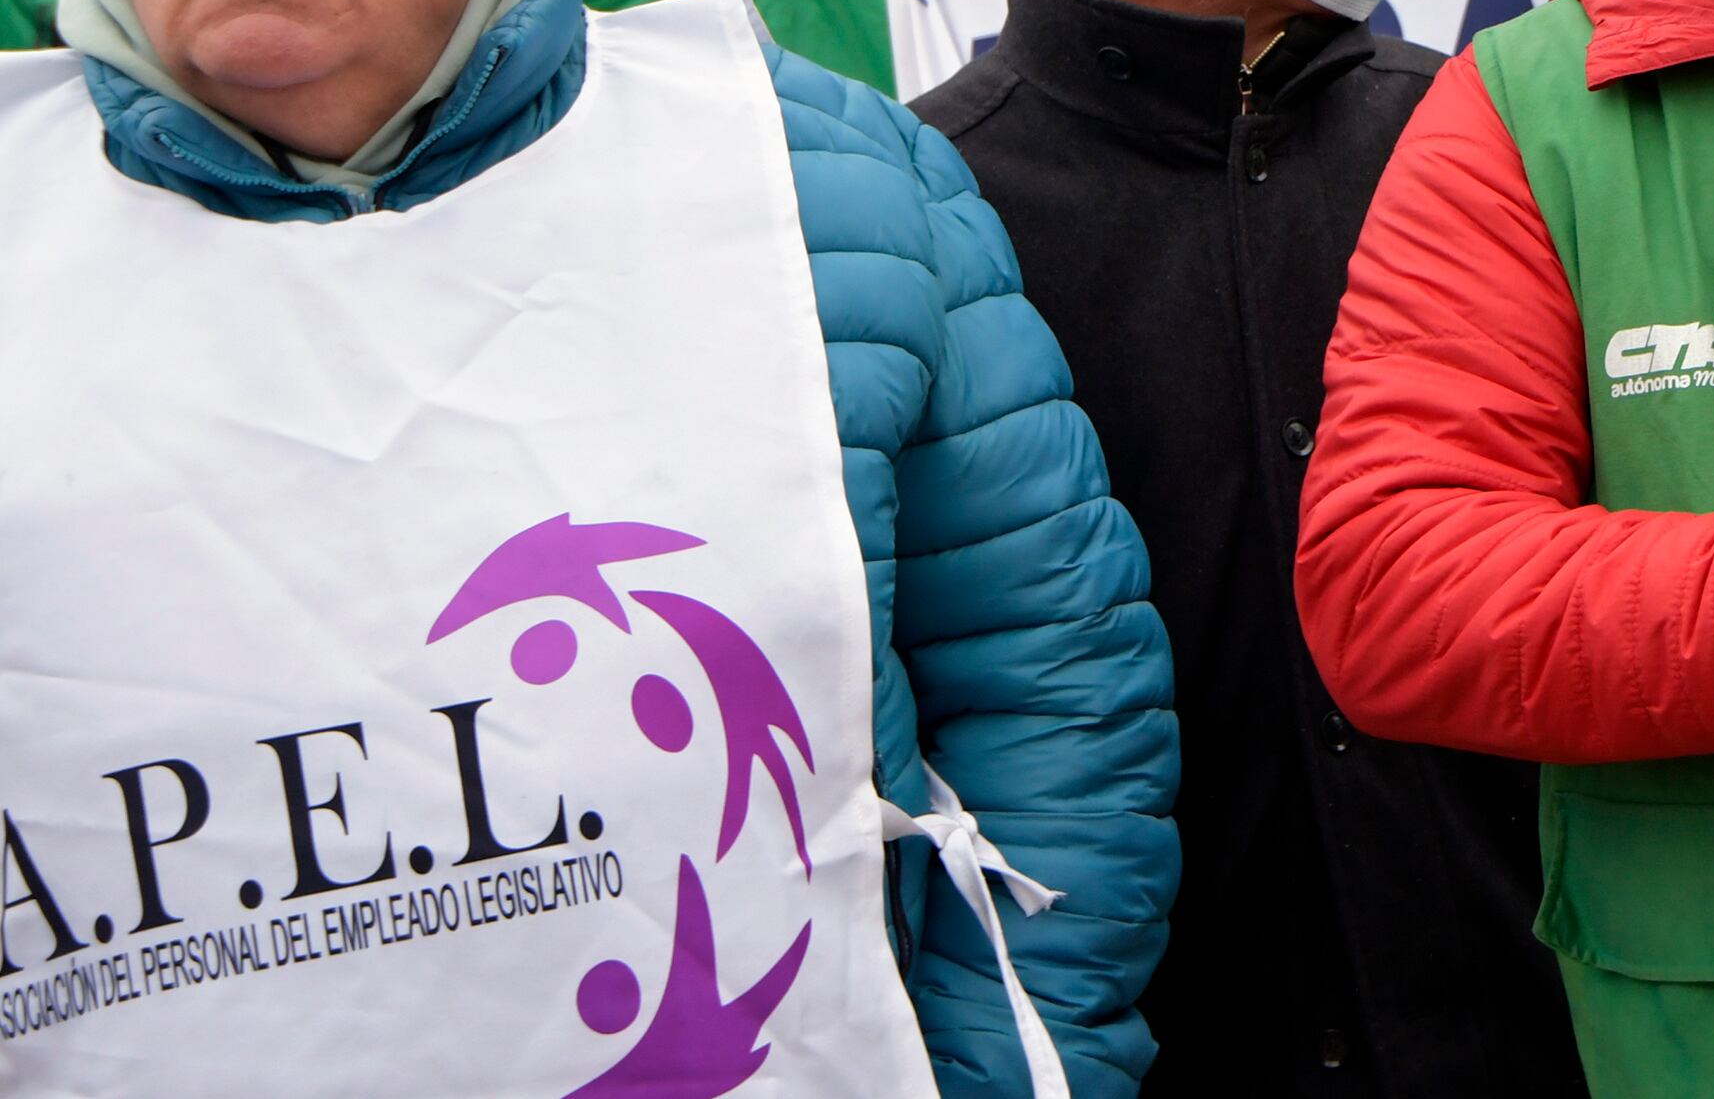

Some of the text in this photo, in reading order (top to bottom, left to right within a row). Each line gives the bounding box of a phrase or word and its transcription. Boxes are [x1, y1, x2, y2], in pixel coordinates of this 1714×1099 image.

[1611, 373, 1692, 398] autónoma
[99, 952, 141, 1007] DEL
[141, 921, 270, 996] PERSONAL
[270, 912, 322, 967] DEL
[322, 882, 461, 956] EMPLEADO
[463, 850, 624, 927] LEGISLATIVO
